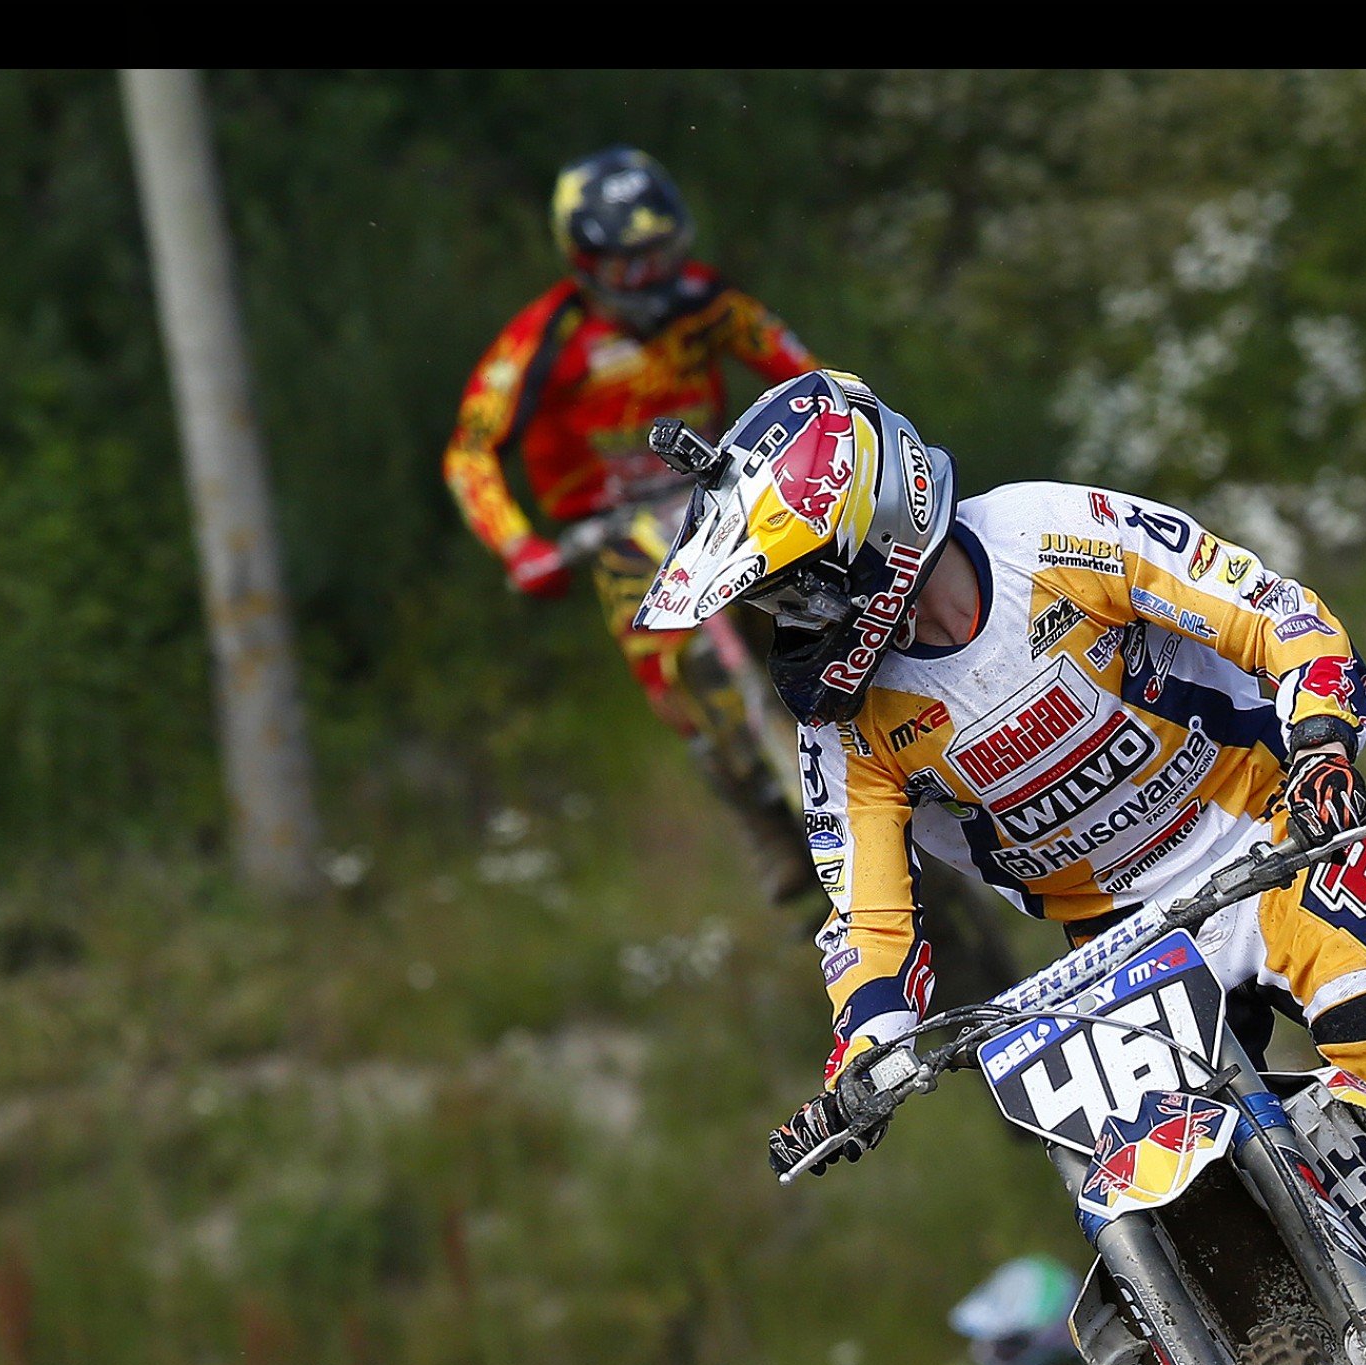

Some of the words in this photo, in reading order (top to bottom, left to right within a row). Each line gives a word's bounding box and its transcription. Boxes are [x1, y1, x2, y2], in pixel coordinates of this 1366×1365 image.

[906, 437, 931, 525] SUOMY
[1038, 553, 1119, 574] supermarkten
[1039, 532, 1124, 561] JUMBO
[698, 558, 765, 615] SUOMY
[820, 617, 892, 694] Red
[863, 542, 923, 624] Bull
[1180, 610, 1210, 638] NL
[889, 700, 951, 753] MX2
[1005, 729, 1148, 836] WILVO
[1039, 731, 1210, 871] Husqvarna
[1144, 780, 1189, 826] FACTORY
[1189, 748, 1218, 788] RACING
[1105, 813, 1201, 894] supermarkten
[1128, 946, 1188, 987] MX2
[1021, 980, 1215, 1141] 461
